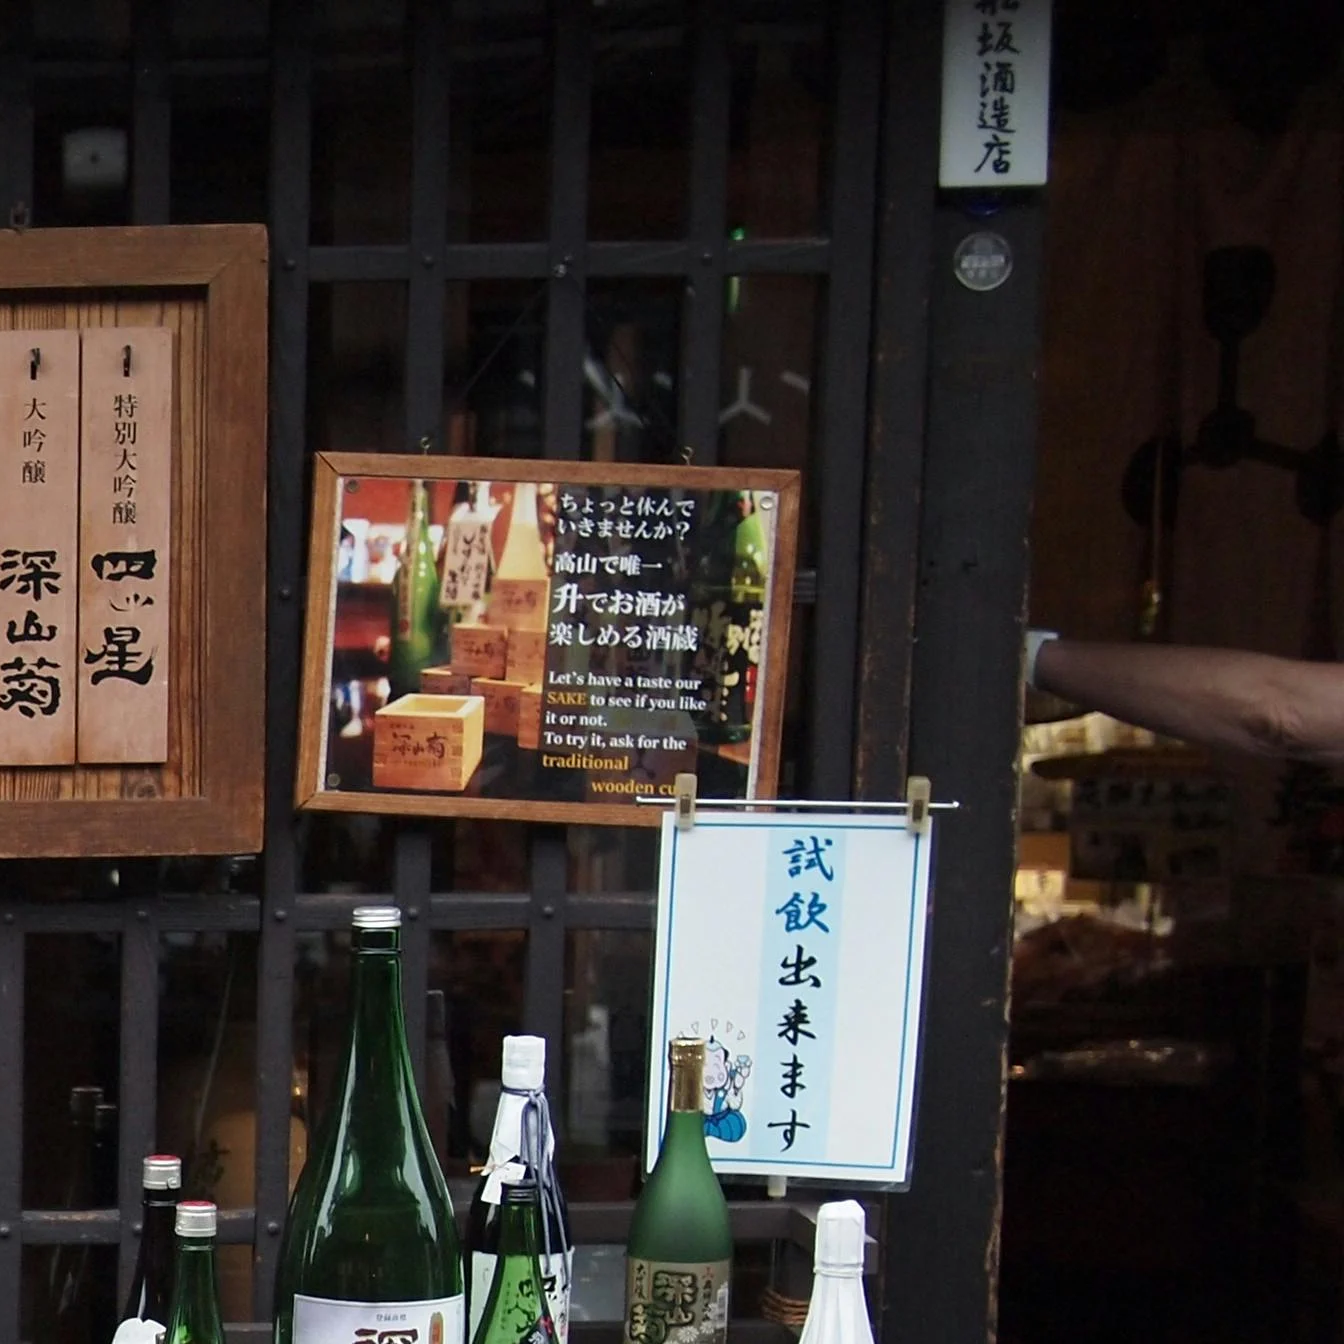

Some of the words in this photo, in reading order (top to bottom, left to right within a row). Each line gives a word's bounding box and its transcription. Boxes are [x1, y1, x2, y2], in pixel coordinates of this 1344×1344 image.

[21, 398, 47, 485] 大吟醸
[112, 394, 137, 525] 特別大吟醸
[560, 493, 695, 517] ちょっと休んで
[558, 517, 690, 540] いきませんか？
[555, 552, 663, 576] 高山で唯一
[552, 583, 686, 617] 升でお酒が
[549, 622, 699, 652] 楽しめる酒蔵
[548, 671, 584, 685] Let's
[588, 673, 622, 687] have
[624, 676, 634, 687] a
[636, 675, 672, 689] taste
[675, 679, 702, 690] our
[547, 691, 586, 705] SAKE
[590, 694, 606, 706] to
[608, 696, 632, 707] see
[635, 694, 648, 708] if
[648, 698, 675, 712] you
[679, 696, 707, 710] like
[545, 711, 556, 725] it
[560, 715, 577, 726] or
[579, 713, 608, 727] not.
[544, 731, 563, 745] To
[566, 734, 588, 749] try
[591, 732, 606, 748] it,
[609, 734, 634, 748] ask
[637, 735, 660, 750] for
[663, 736, 687, 750] the
[542, 754, 630, 770] traditional
[591, 779, 654, 794] wooden
[659, 783, 676, 795] cu
[767, 836, 834, 1153] 試飲出来ます
